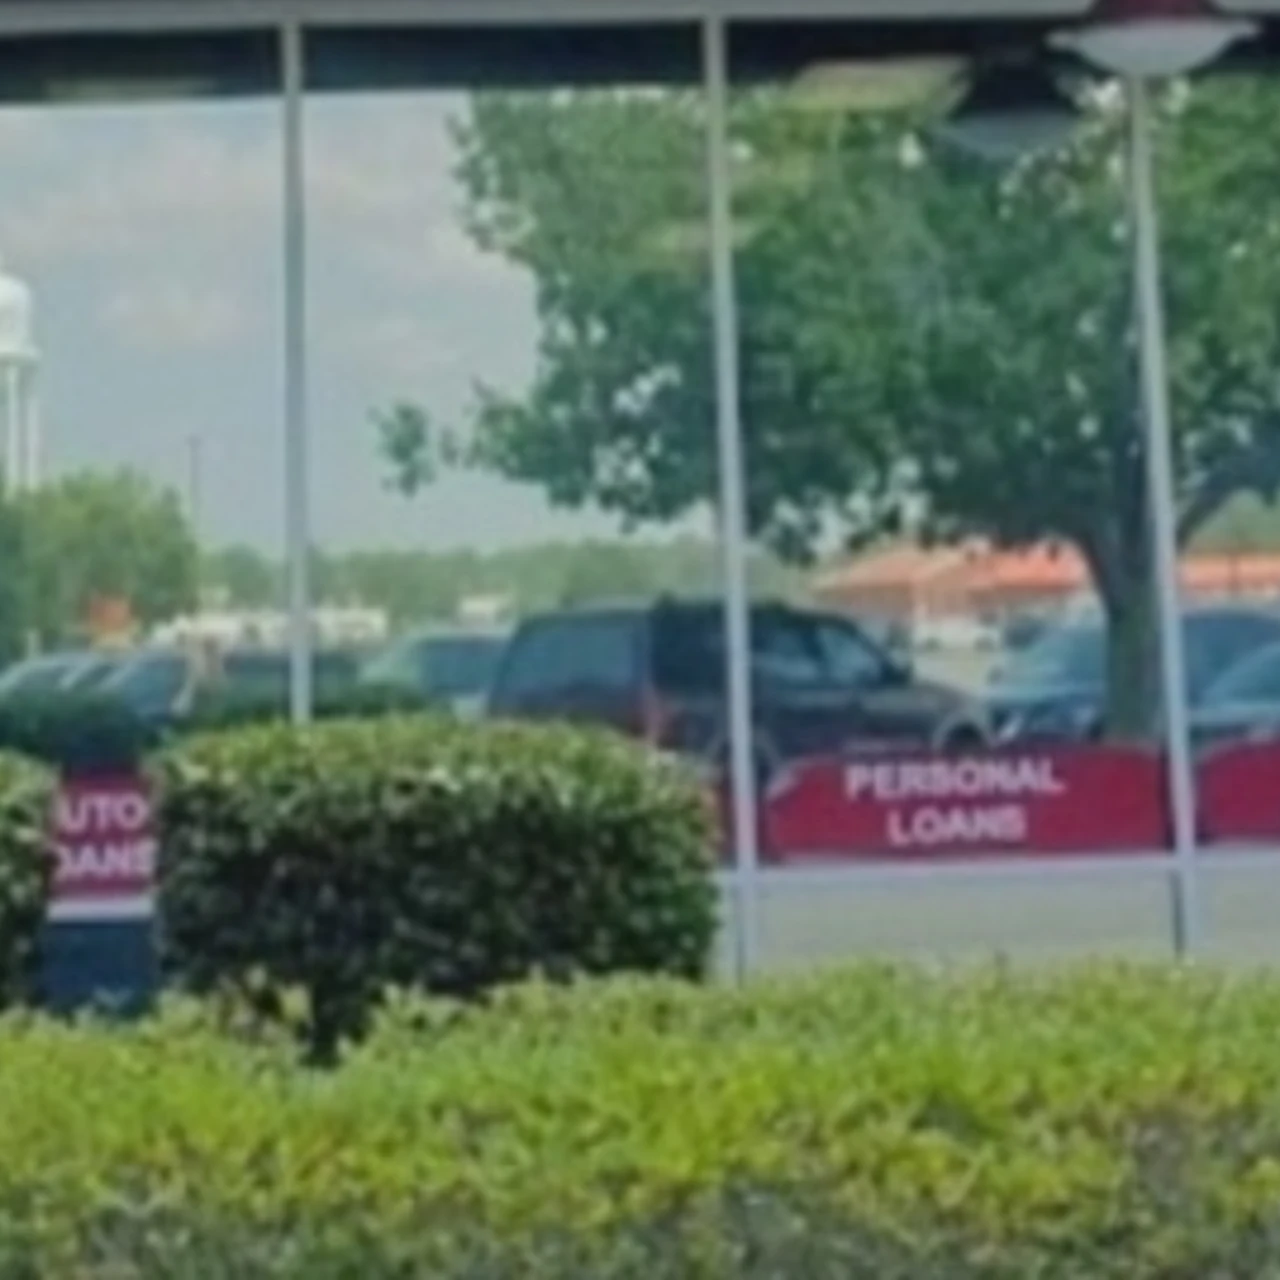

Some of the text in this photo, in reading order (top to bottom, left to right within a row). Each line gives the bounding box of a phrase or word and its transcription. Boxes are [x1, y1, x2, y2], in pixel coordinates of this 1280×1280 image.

[845, 760, 1066, 800] PERSONAL
[57, 794, 148, 832] UTO
[887, 805, 1026, 846] LOANS
